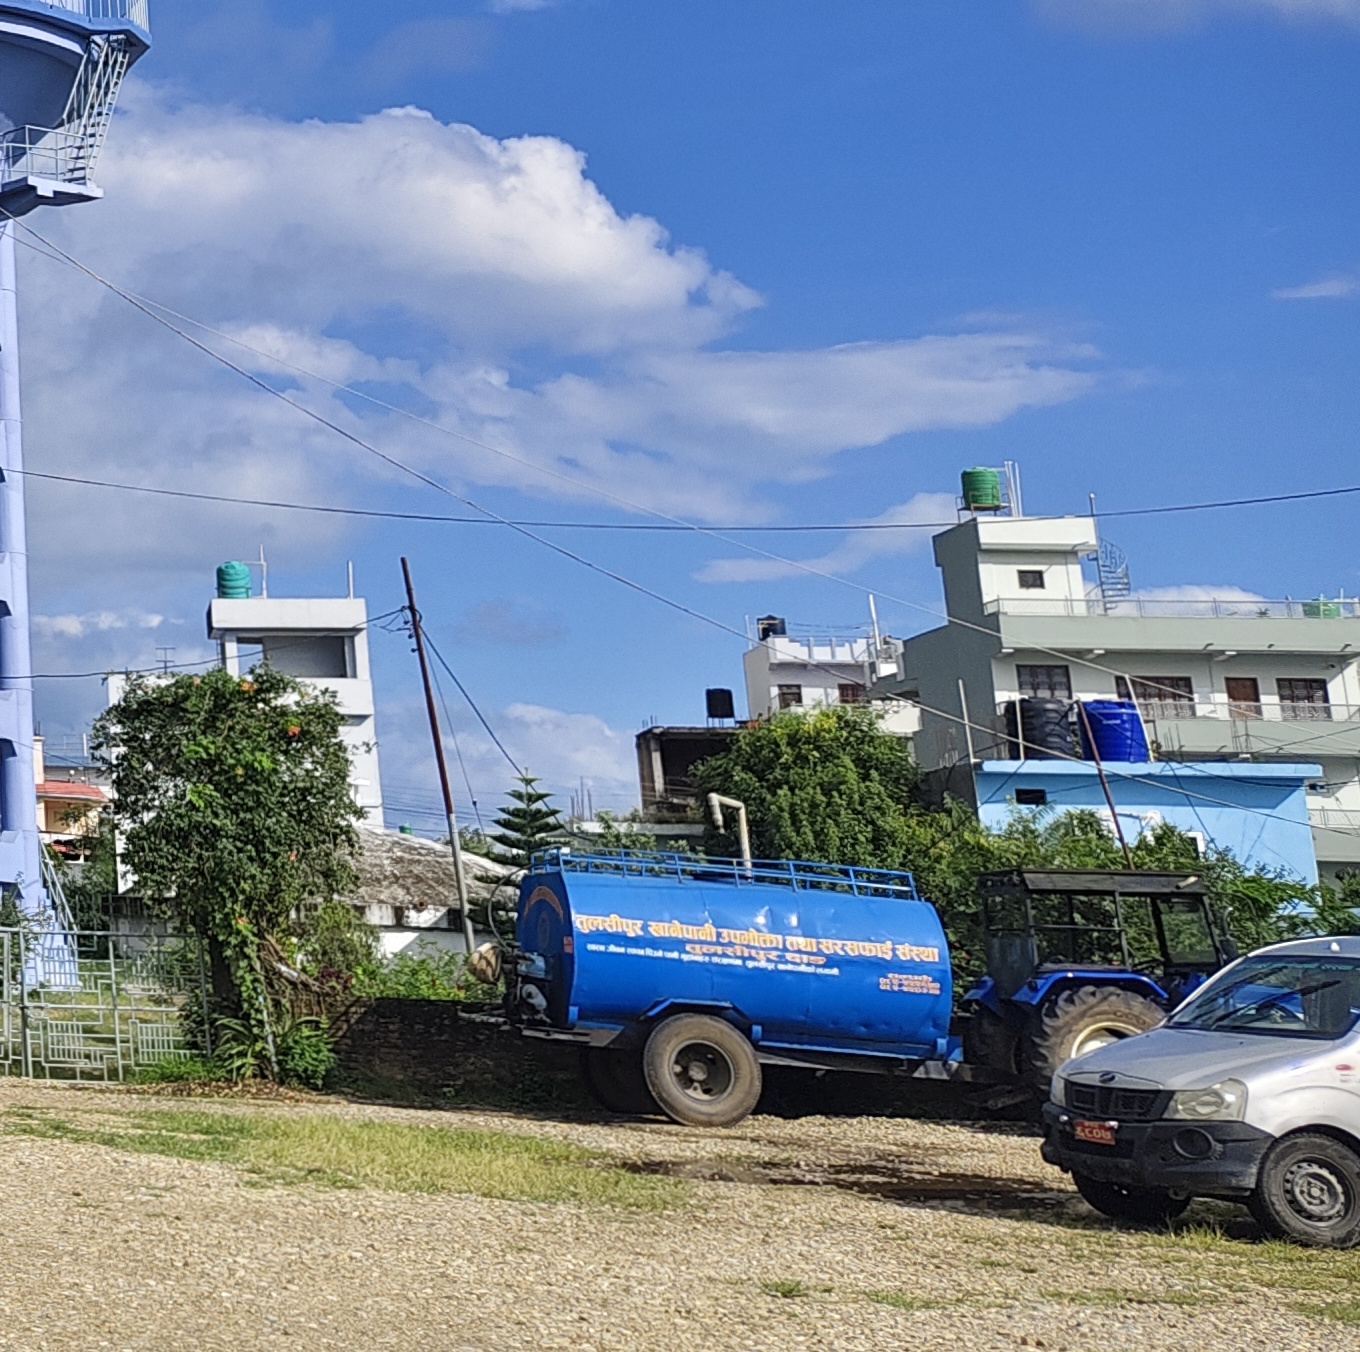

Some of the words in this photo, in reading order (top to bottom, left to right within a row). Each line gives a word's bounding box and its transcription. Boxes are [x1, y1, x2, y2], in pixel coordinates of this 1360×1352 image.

[575, 914, 644, 937] तुलसीपुर
[648, 920, 717, 942] खानेपानी
[785, 935, 817, 952] तथा
[895, 943, 939, 962] संस्था
